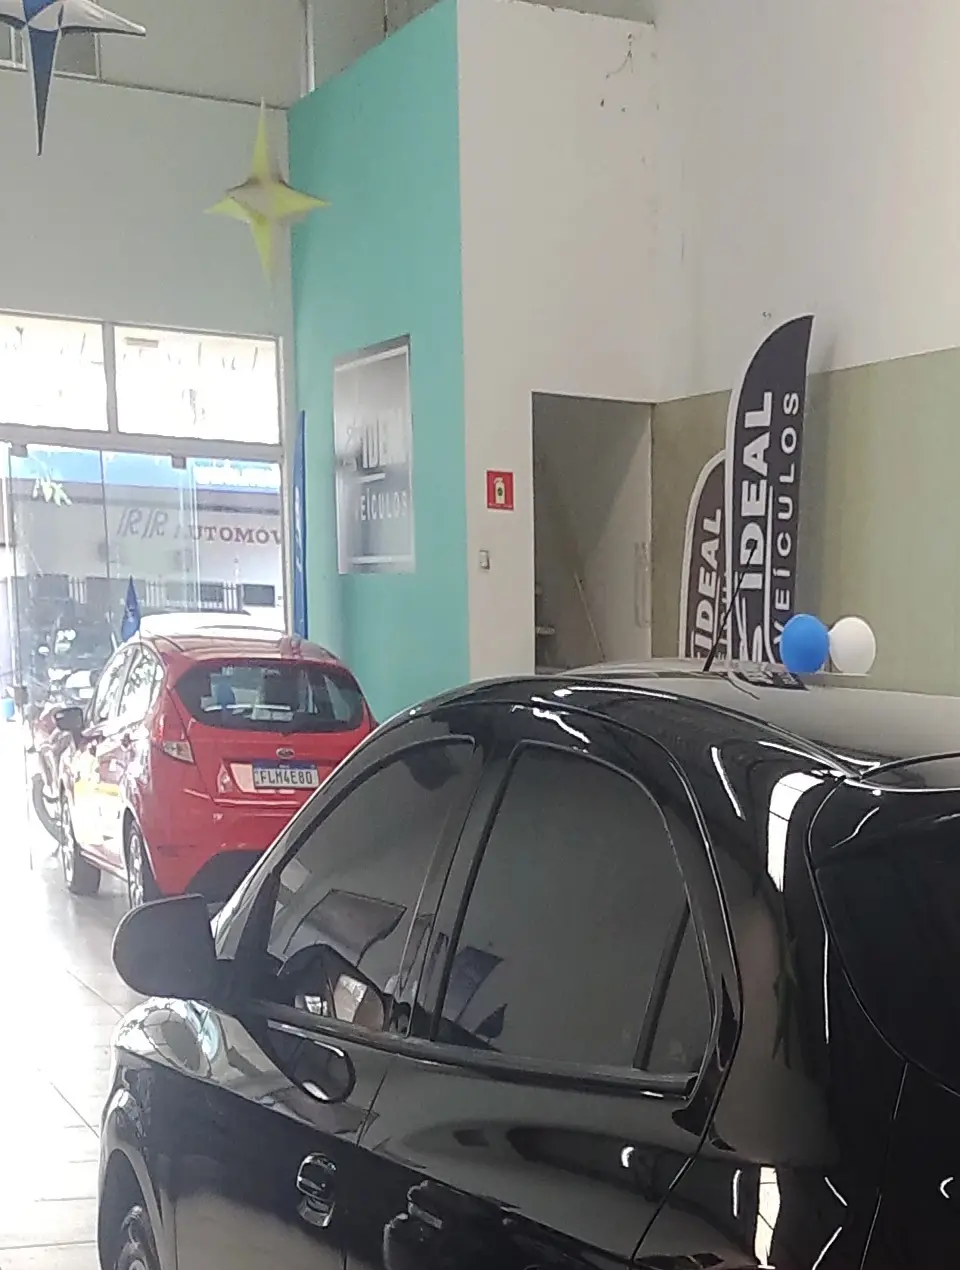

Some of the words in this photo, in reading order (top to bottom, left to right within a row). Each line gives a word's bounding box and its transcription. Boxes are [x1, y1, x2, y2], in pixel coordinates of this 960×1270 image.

[740, 392, 773, 589] IDEAL
[695, 508, 721, 650] IDEAL
[259, 769, 313, 785] FLM4E80
